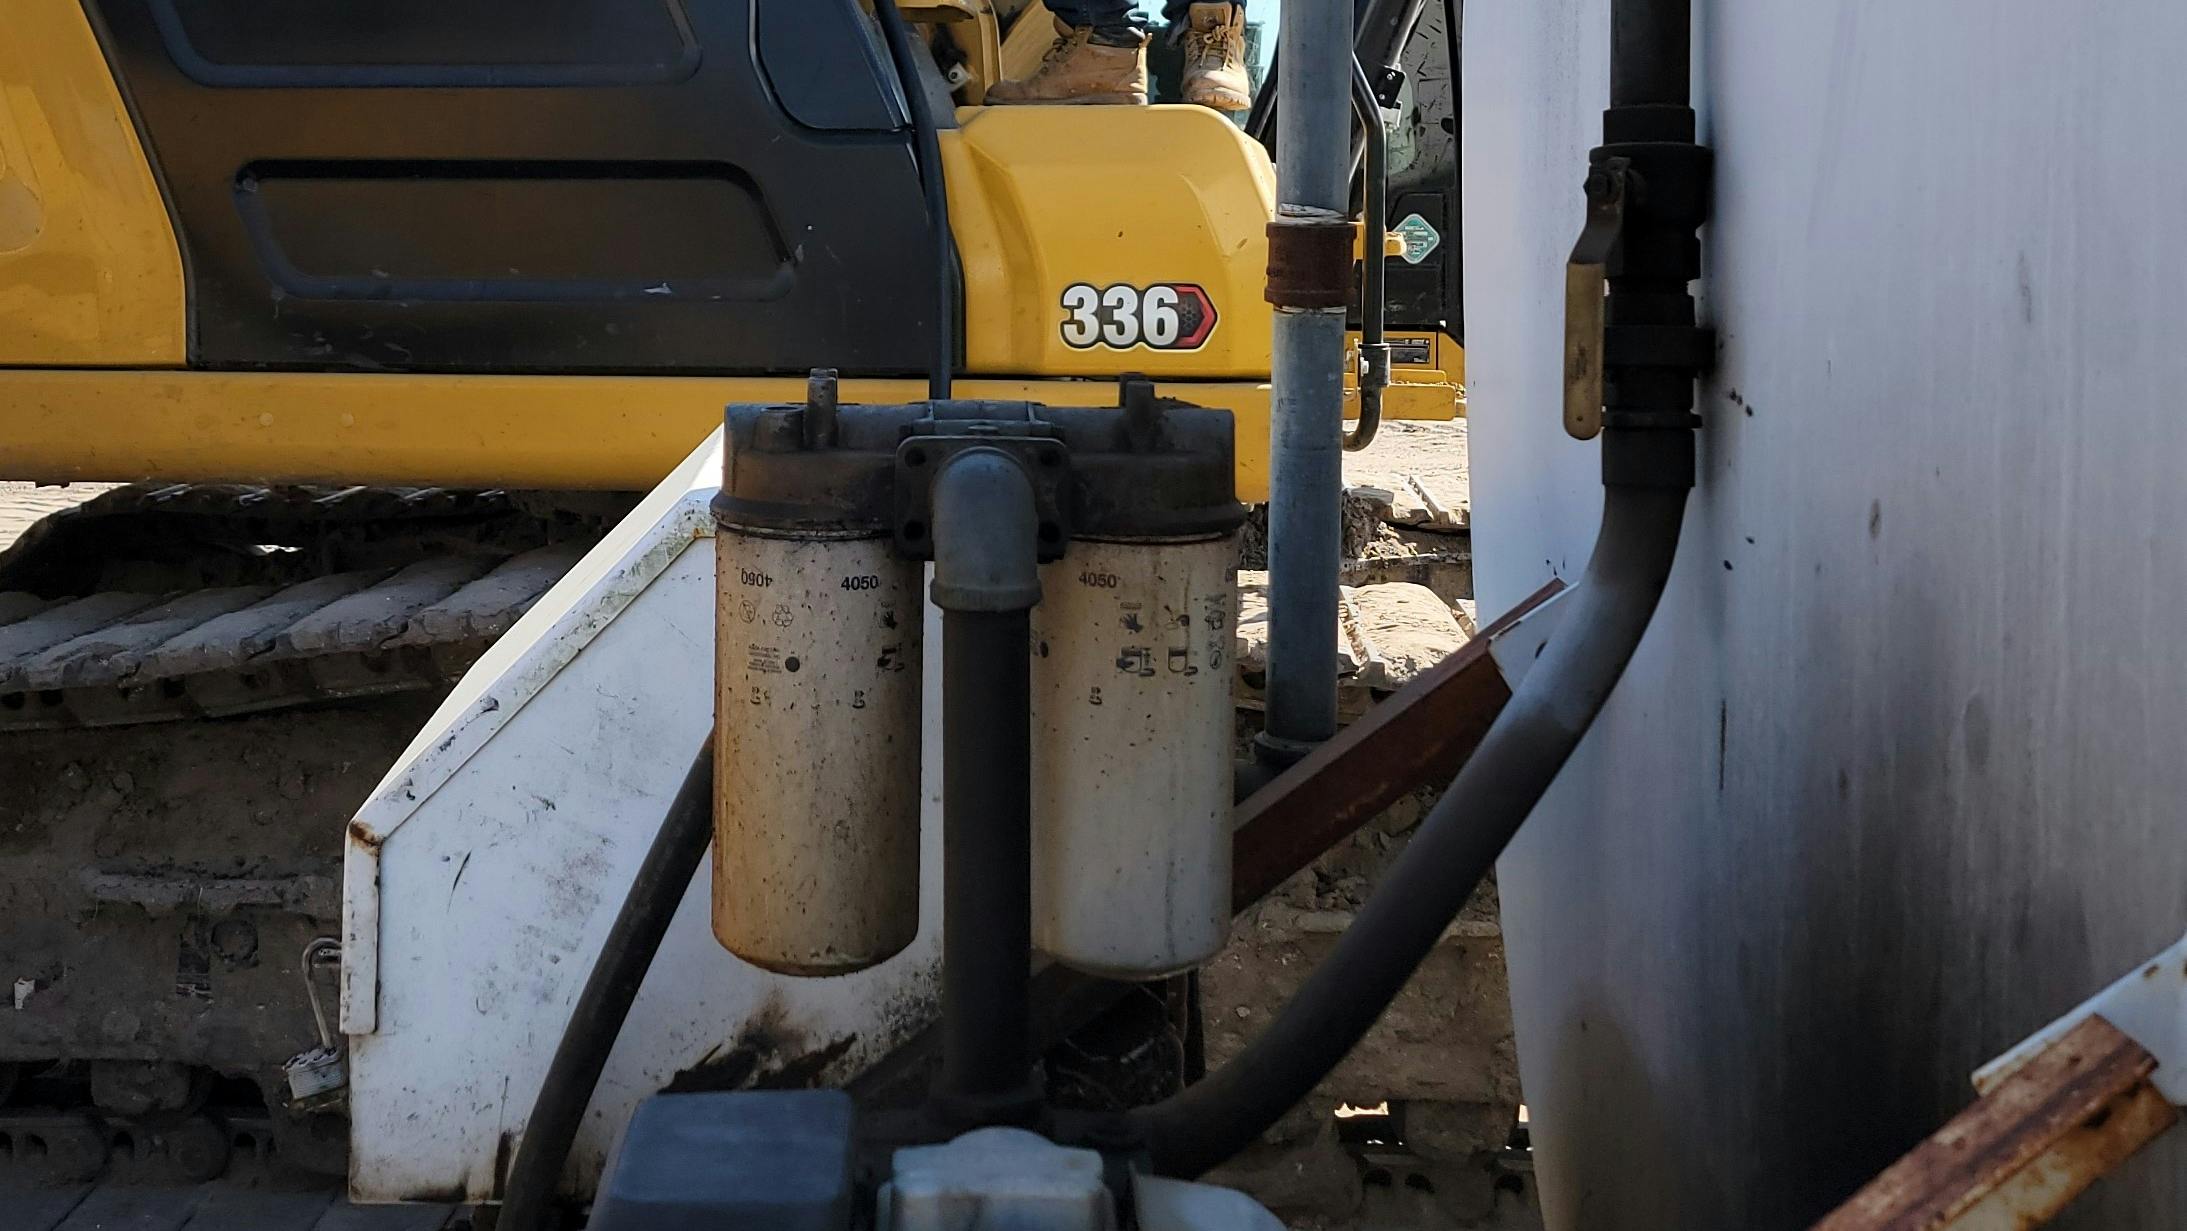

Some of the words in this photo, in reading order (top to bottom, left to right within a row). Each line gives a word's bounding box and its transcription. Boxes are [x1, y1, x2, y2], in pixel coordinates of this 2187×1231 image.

[1062, 284, 1180, 347] 336
[840, 575, 879, 591] 4050
[1078, 572, 1118, 589] 4050
